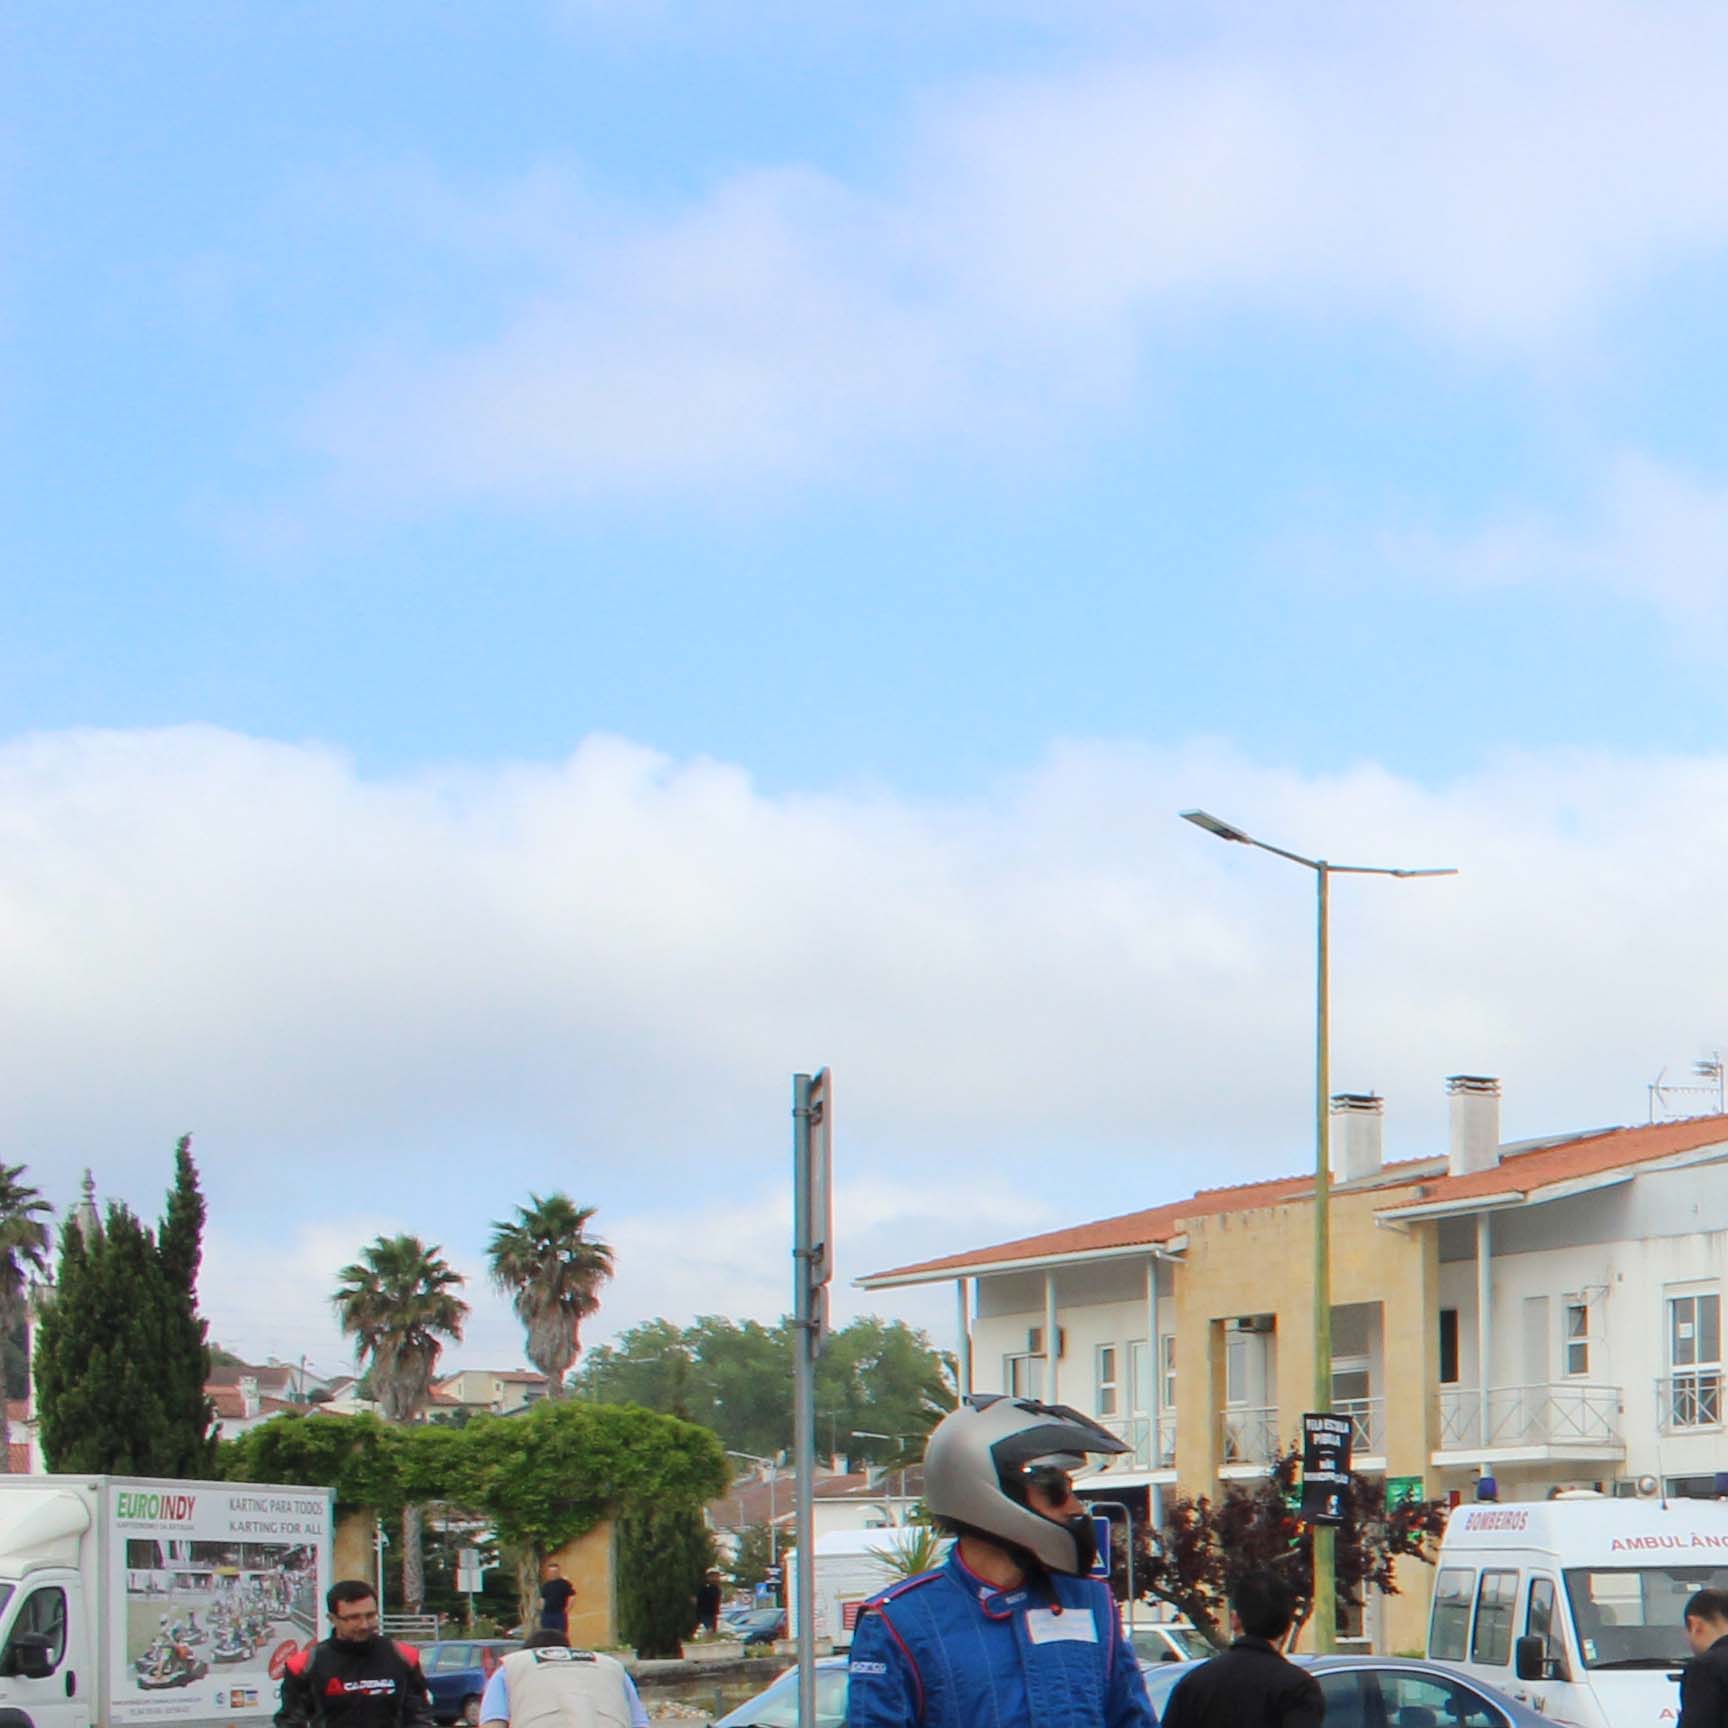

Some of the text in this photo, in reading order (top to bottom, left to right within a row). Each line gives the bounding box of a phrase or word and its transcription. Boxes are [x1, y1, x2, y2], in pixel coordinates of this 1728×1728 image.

[116, 1492, 196, 1521] EUROINDY
[229, 1498, 268, 1513] KARTING
[294, 1501, 324, 1516] TODOS
[229, 1520, 323, 1535] KARTING FOR ALL
[1464, 1511, 1529, 1531] BOMBEIROS
